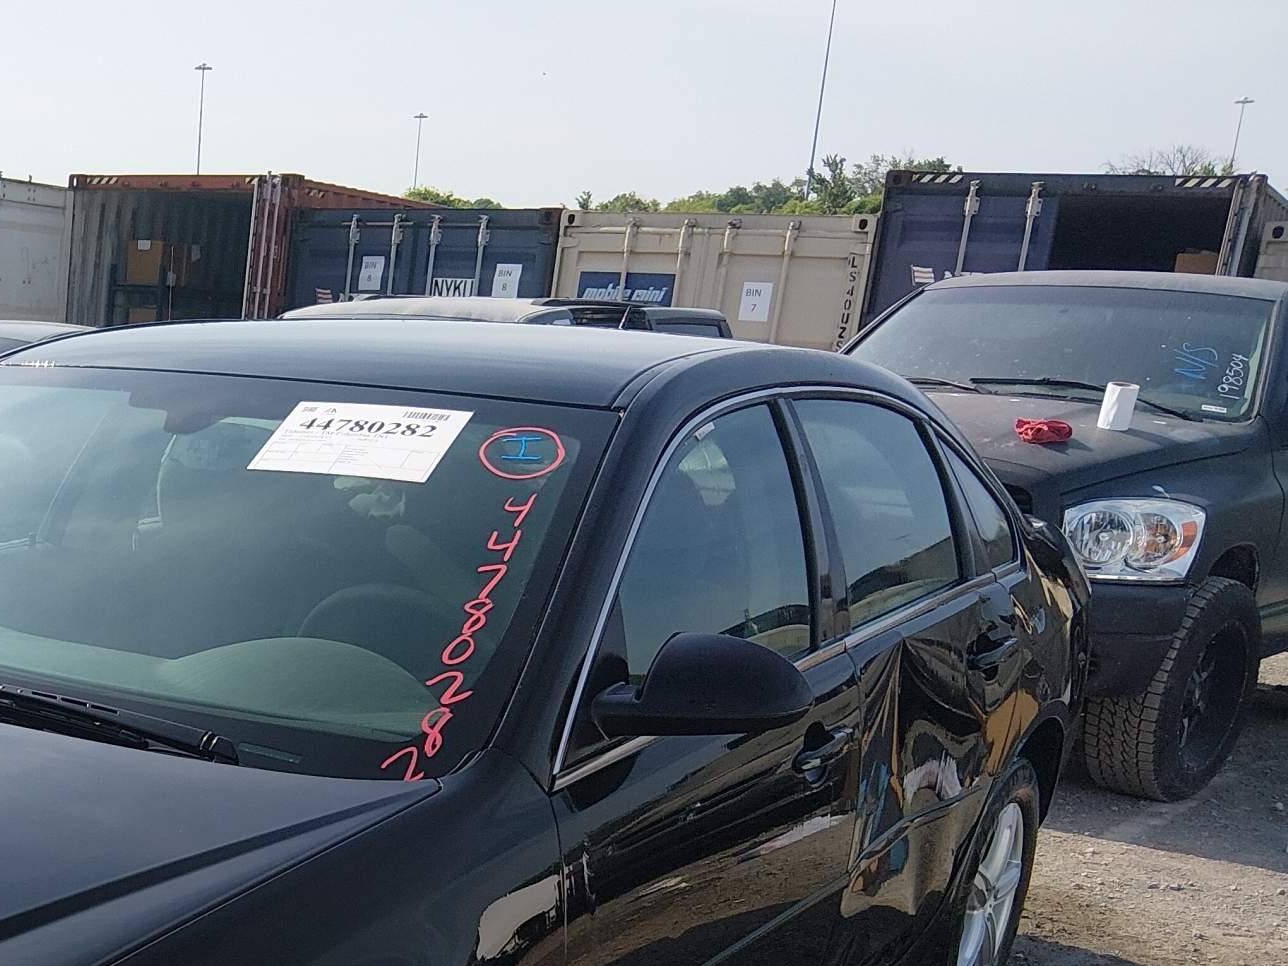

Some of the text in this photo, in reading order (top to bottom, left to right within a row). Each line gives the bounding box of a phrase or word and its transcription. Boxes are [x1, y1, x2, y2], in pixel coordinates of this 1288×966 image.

[745, 288, 762, 297] BIN
[750, 303, 757, 313] 7
[1217, 353, 1249, 400] 198504
[299, 417, 438, 438] 44780282
[380, 493, 538, 783] 44780282
